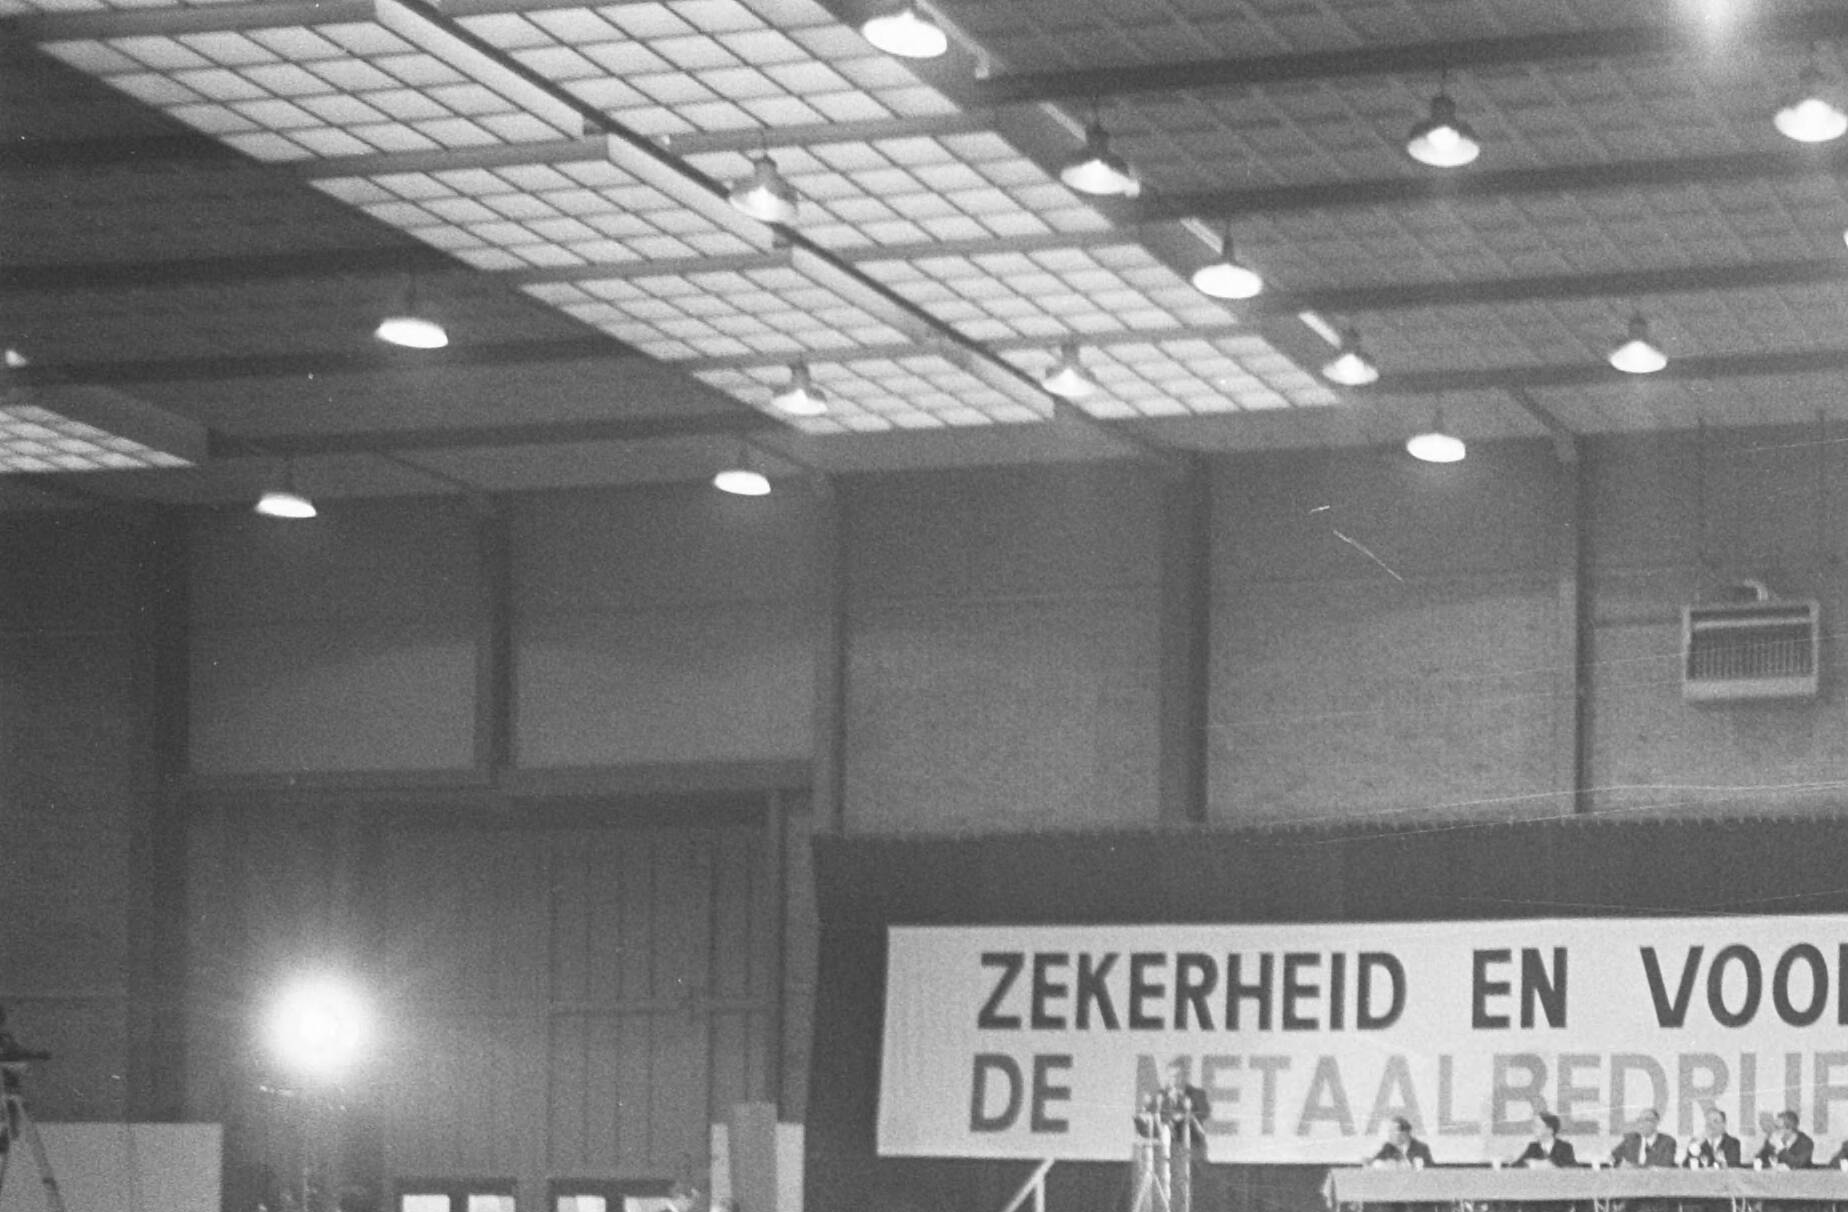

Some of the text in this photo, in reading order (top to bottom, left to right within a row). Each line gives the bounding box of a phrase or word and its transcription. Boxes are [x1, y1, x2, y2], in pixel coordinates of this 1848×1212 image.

[976, 950, 1406, 1031] ZEKERHEID
[1472, 946, 1568, 1030] EN
[969, 1052, 1073, 1134] DE
